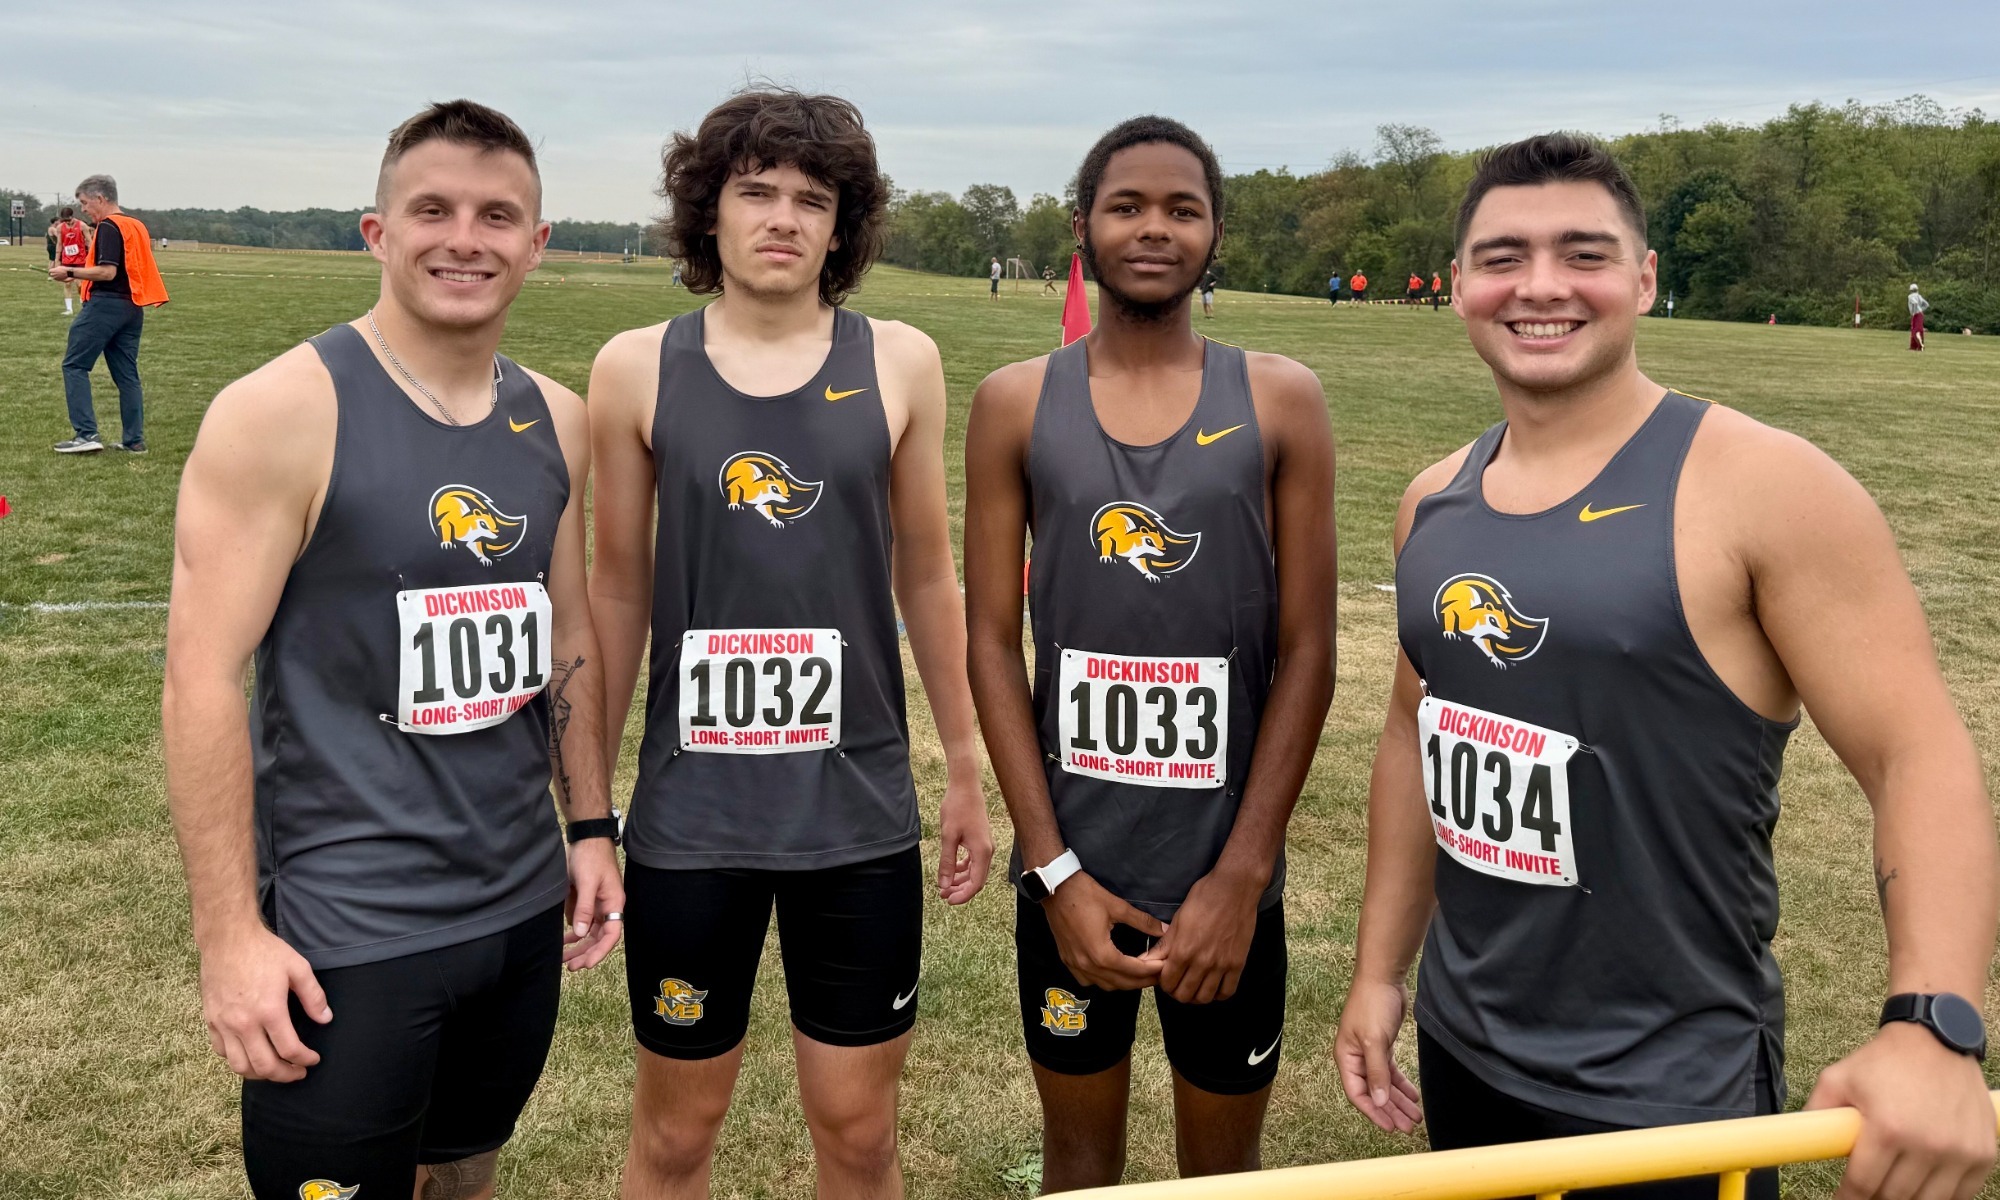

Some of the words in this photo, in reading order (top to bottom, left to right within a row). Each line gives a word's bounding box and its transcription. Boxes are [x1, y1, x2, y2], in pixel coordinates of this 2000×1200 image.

[425, 587, 528, 617] DICKINSON
[413, 611, 543, 704] 1031
[708, 633, 814, 655] DICKINSON
[1086, 657, 1200, 684] DICKINSON
[690, 657, 833, 727] 1032
[412, 698, 505, 726] LONG-SHORT
[1070, 681, 1219, 760] 1033
[691, 730, 781, 746] LONG-SHORT
[785, 728, 830, 744] INVITE
[1438, 706, 1547, 759] DICKINSON
[1070, 752, 1164, 778] LONG-SHORT
[1168, 762, 1216, 779] INVITE
[1427, 733, 1562, 853] 1034
[1505, 848, 1562, 876] INVITE
